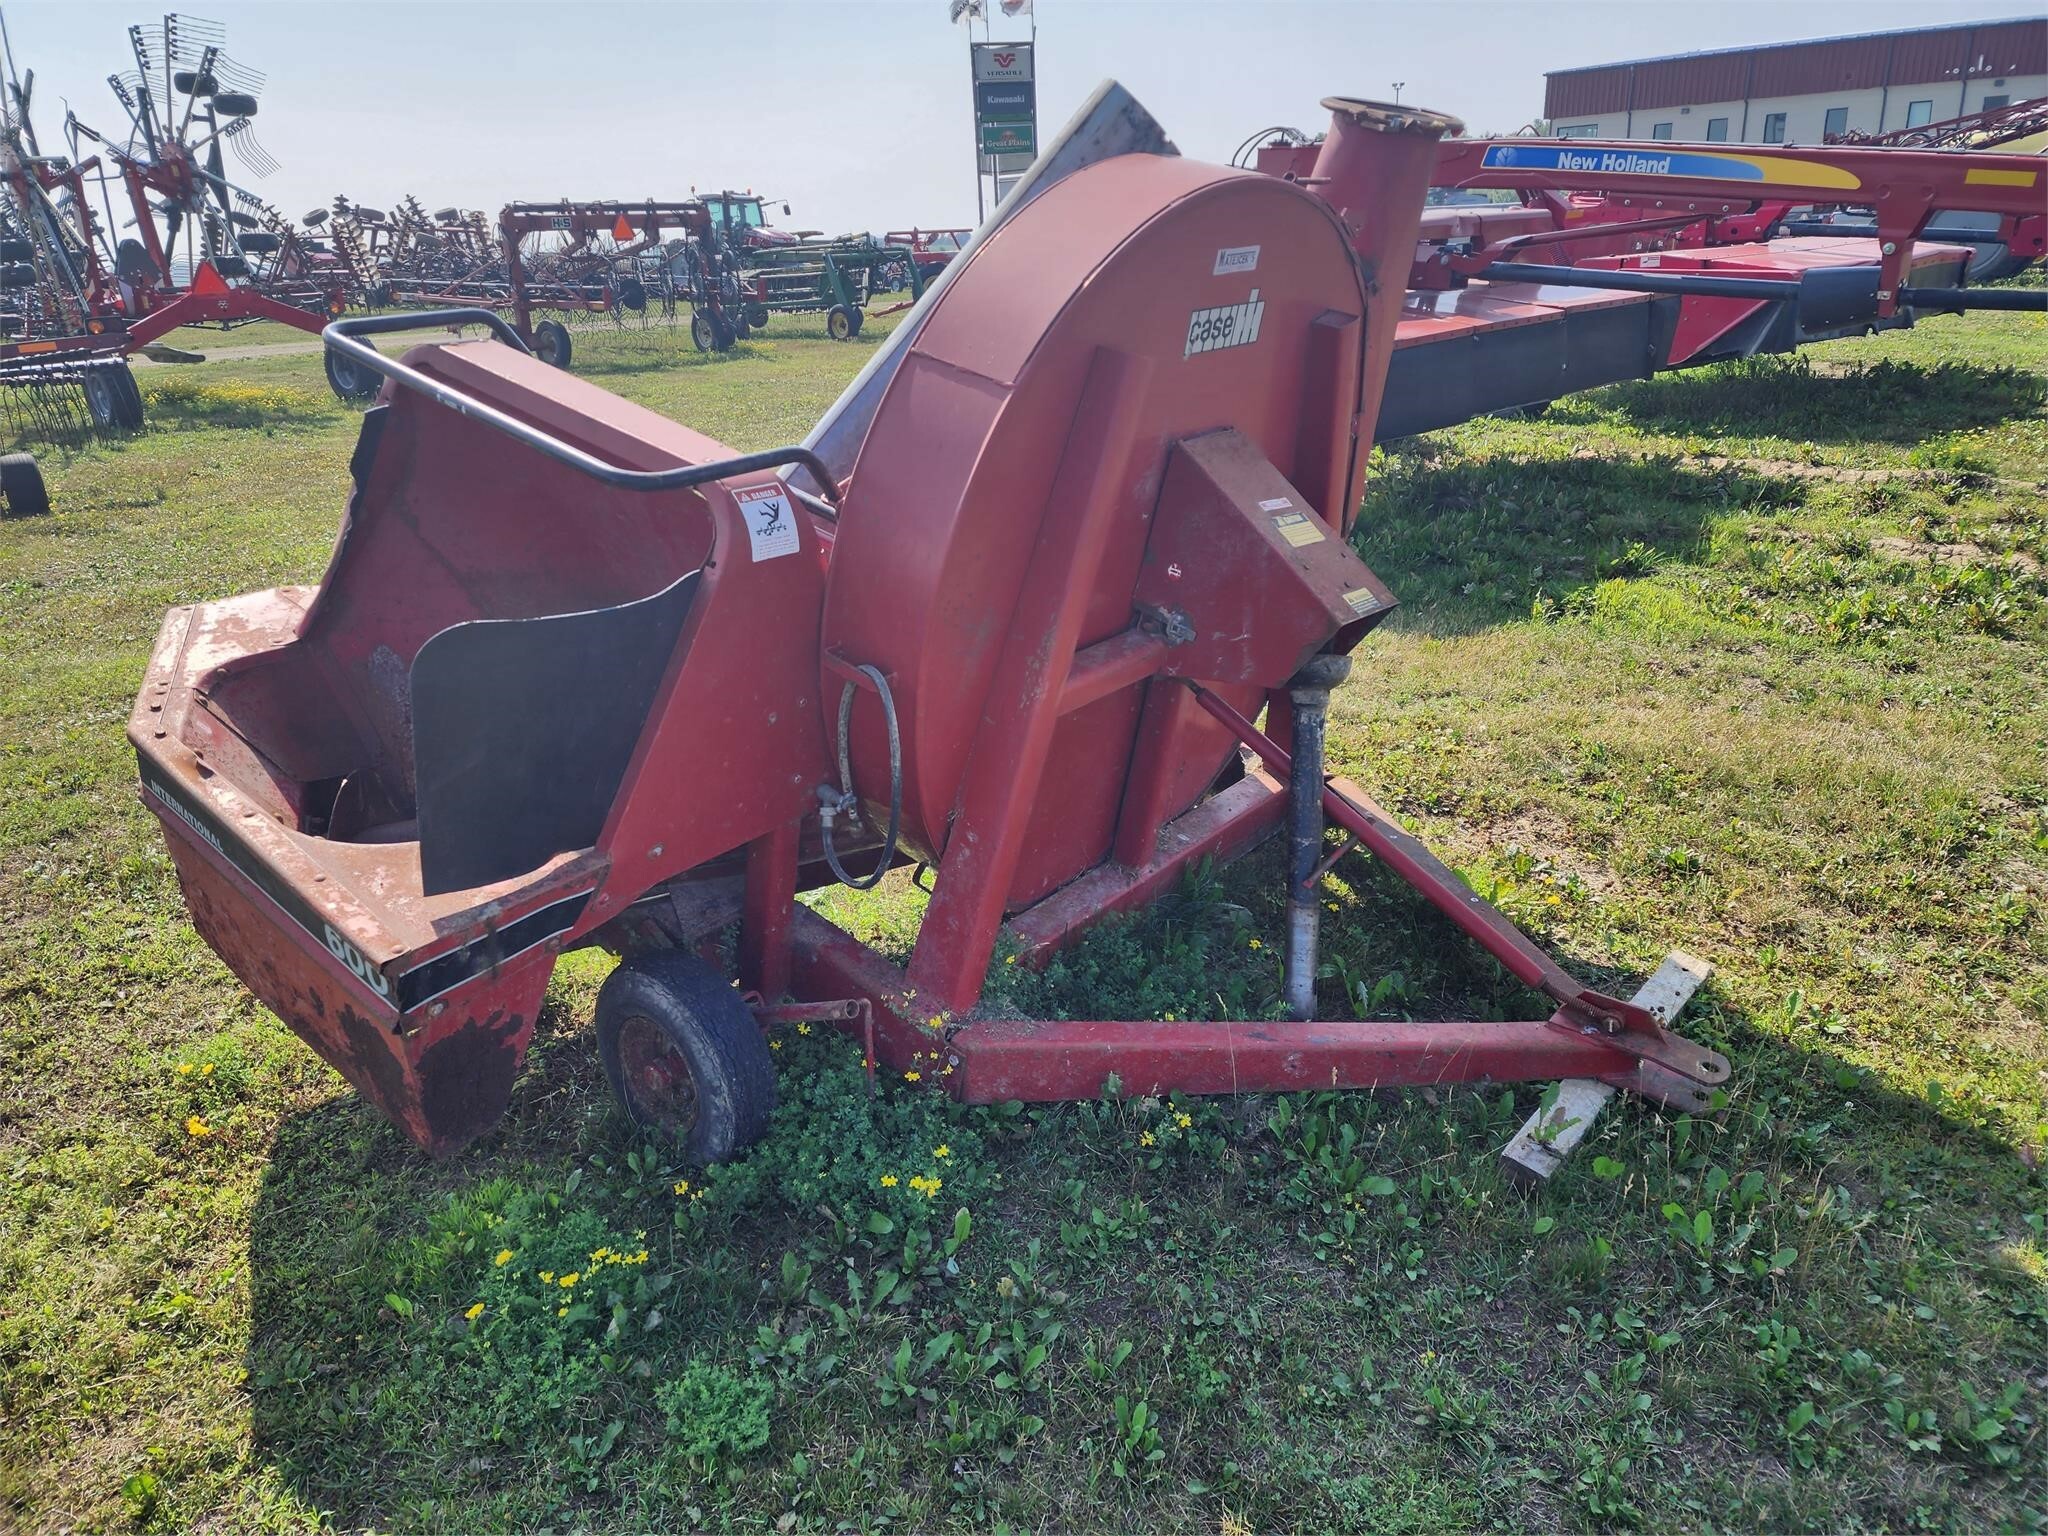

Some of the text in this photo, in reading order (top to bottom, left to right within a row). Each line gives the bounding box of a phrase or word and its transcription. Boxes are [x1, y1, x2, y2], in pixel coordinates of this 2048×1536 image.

[987, 95, 1025, 104] Kawasaki
[986, 136, 1031, 148] Great Plains
[1557, 152, 1671, 174] New Holland
[1188, 315, 1235, 348] case
[750, 488, 778, 500] DANGER
[150, 778, 224, 853] INTERNATIONAL
[323, 923, 390, 996] 600
